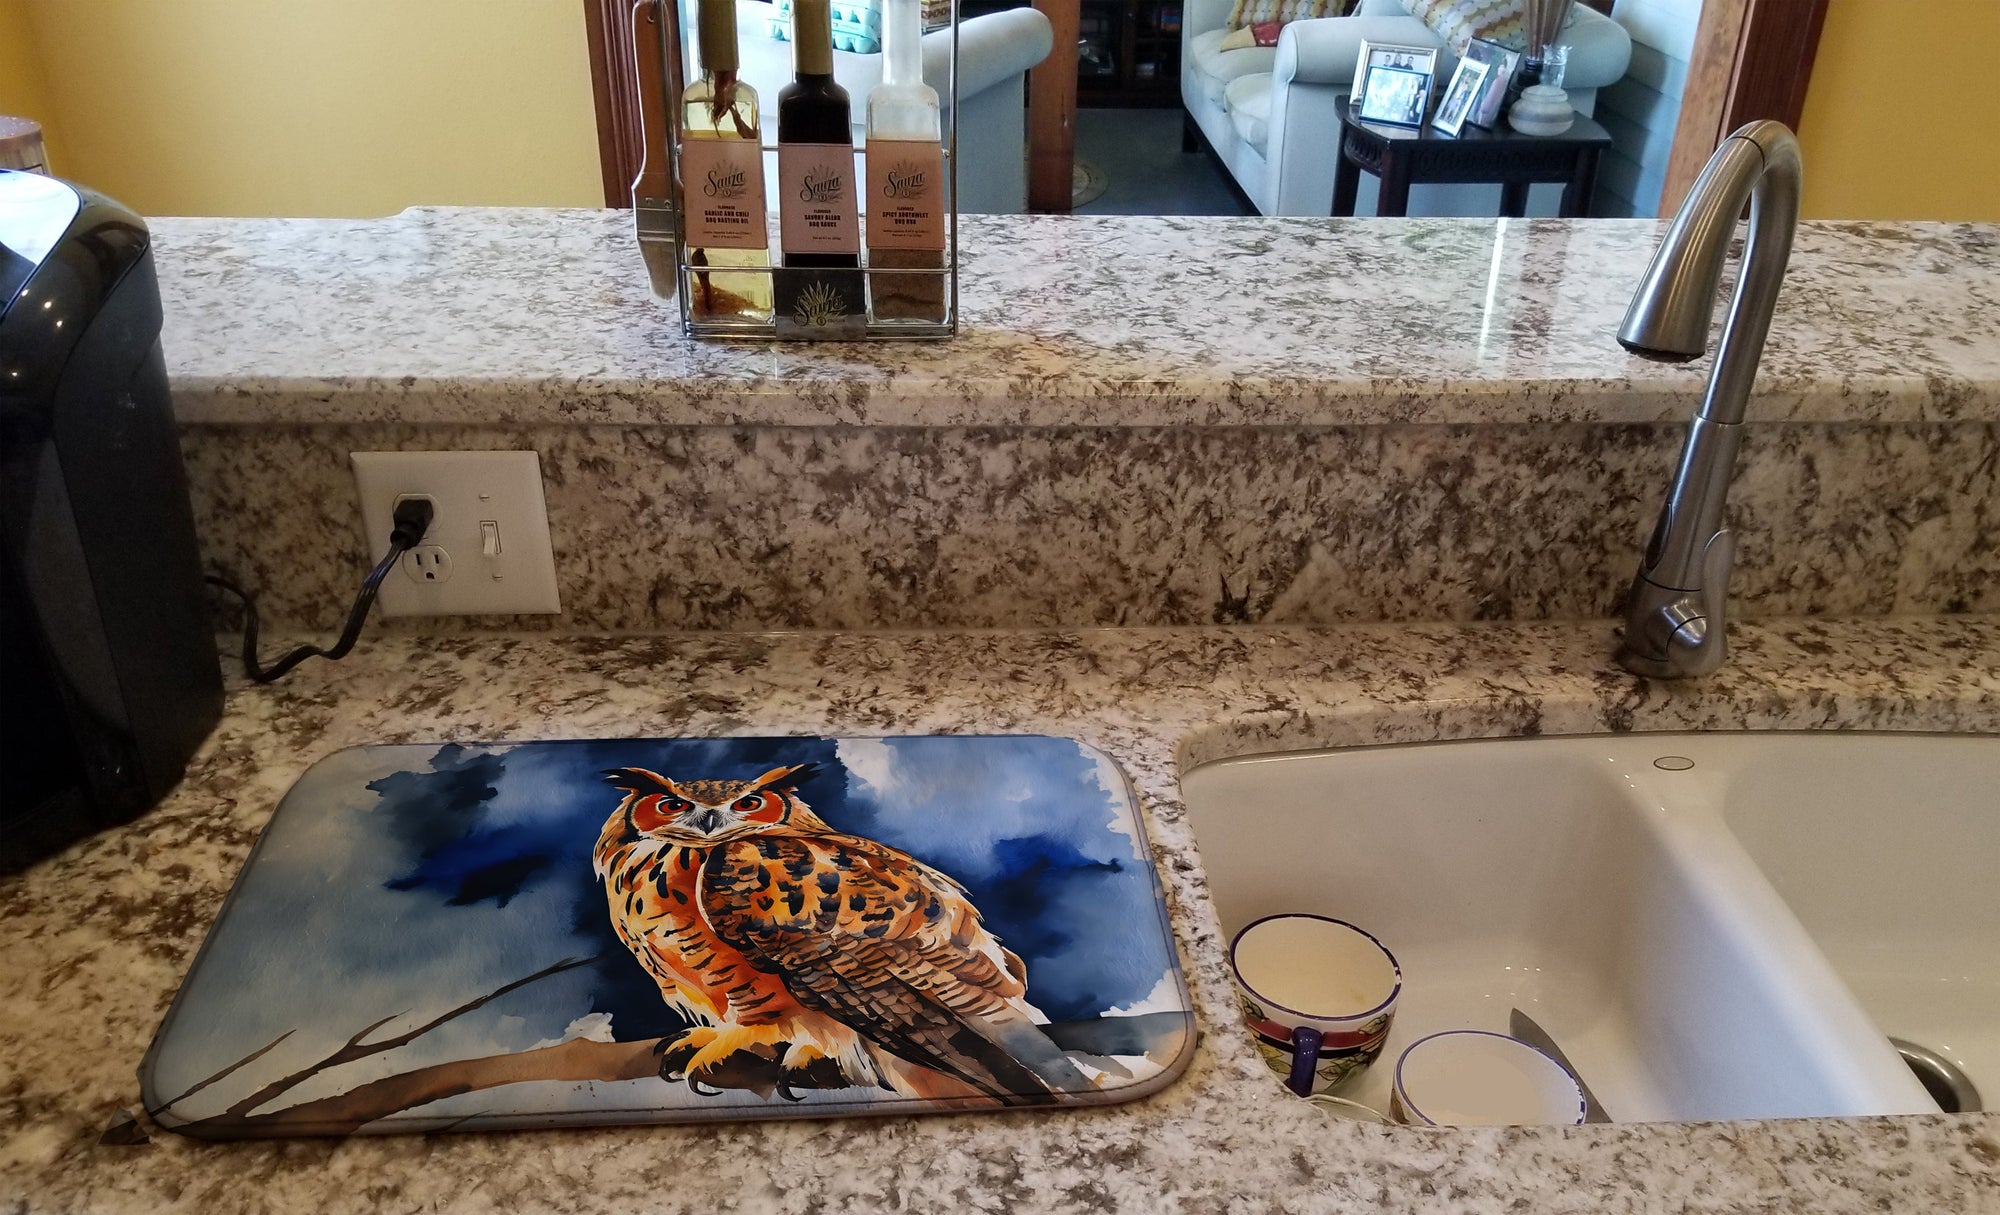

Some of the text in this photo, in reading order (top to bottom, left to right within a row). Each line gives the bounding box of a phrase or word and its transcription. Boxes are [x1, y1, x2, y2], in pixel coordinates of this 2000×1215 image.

[704, 170, 745, 197] Sauza
[800, 175, 841, 202] Sauza
[884, 171, 924, 198] Sauza
